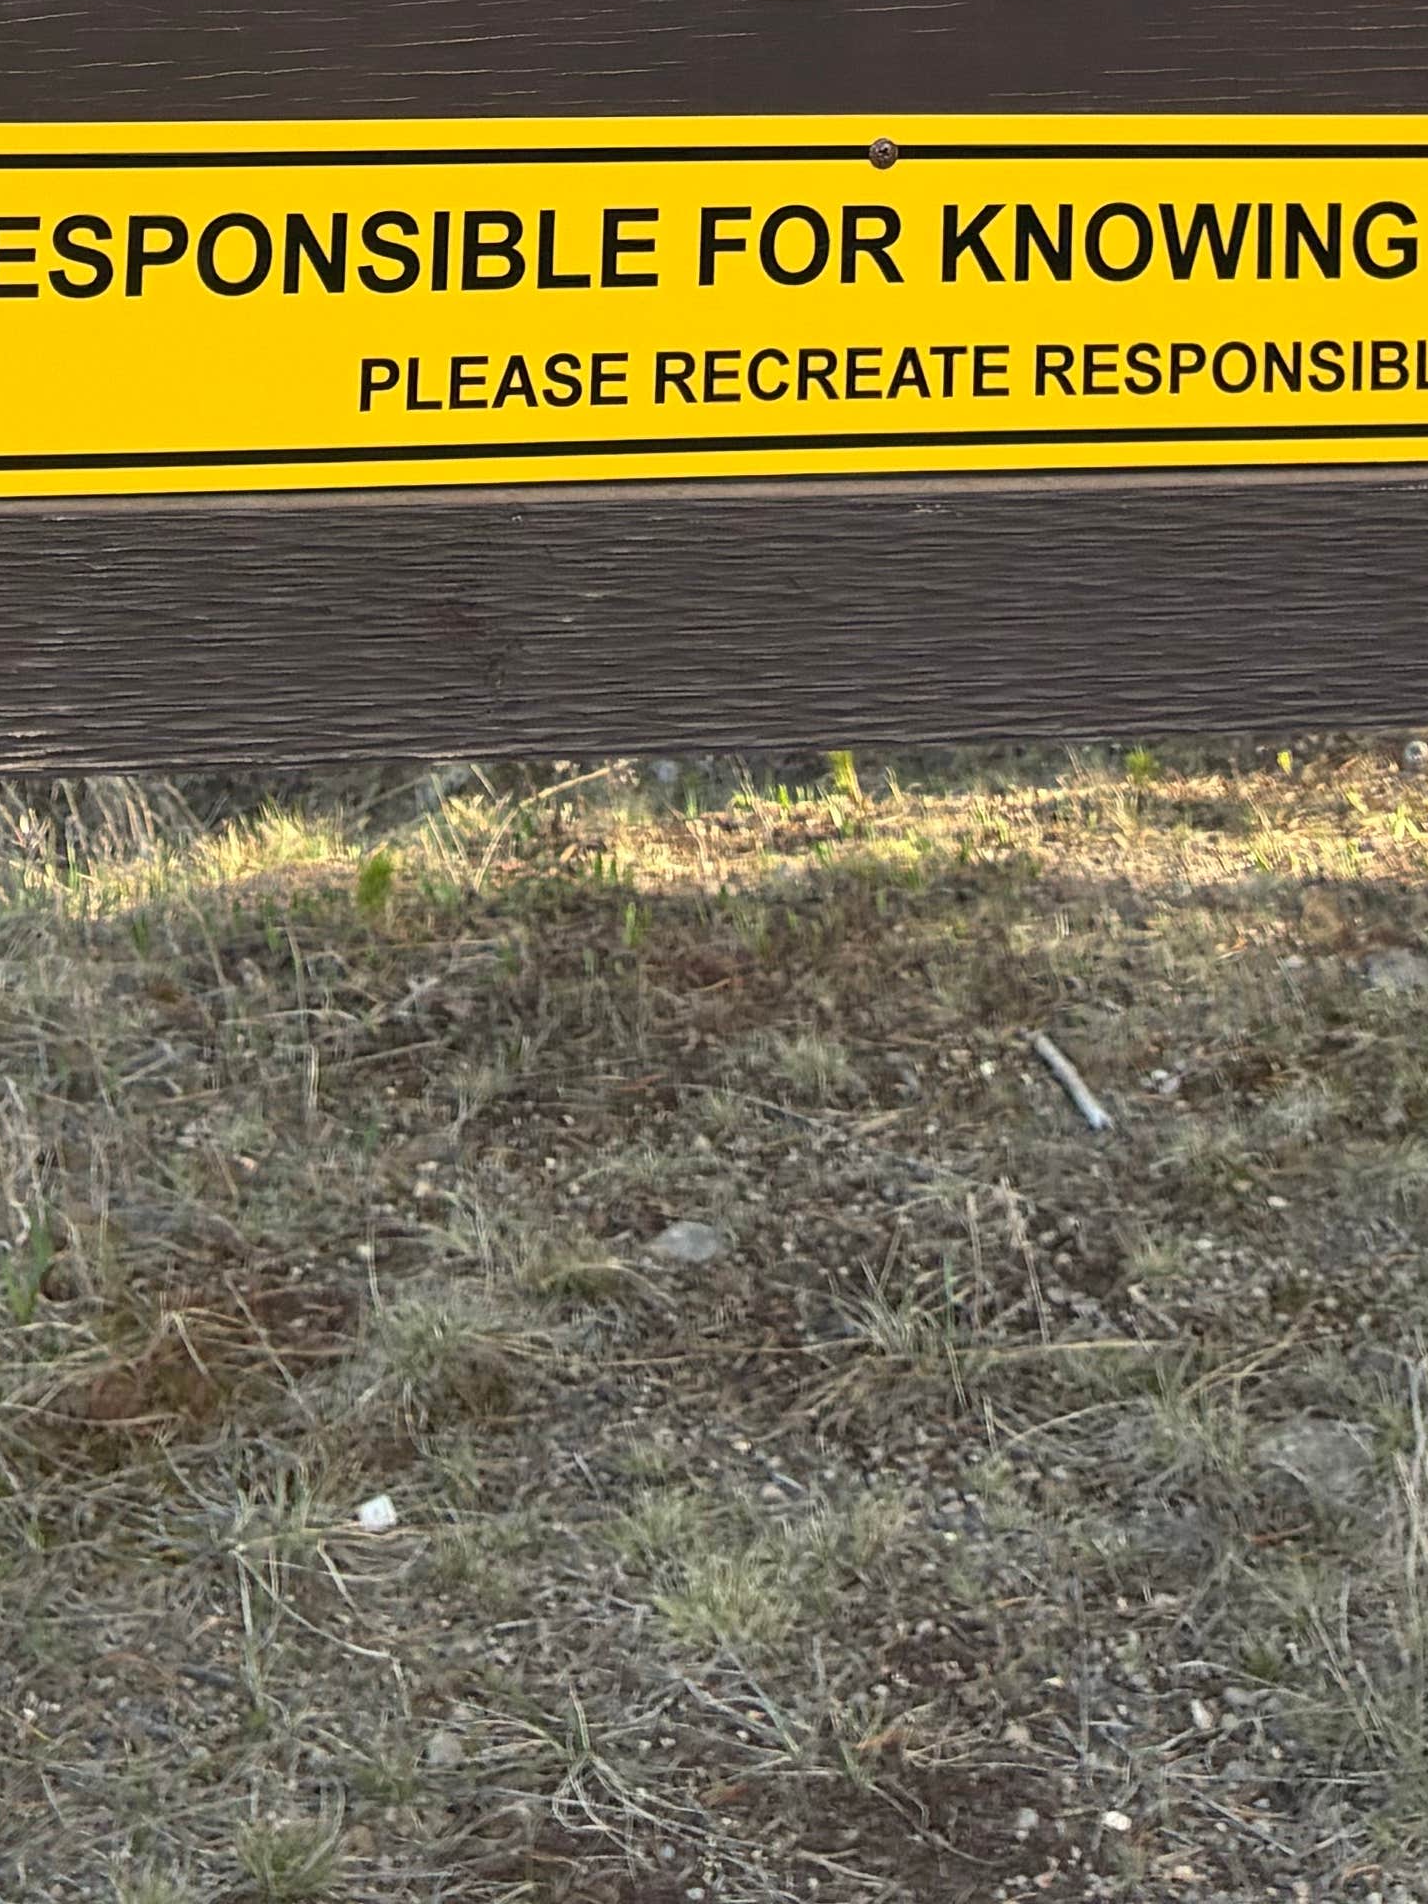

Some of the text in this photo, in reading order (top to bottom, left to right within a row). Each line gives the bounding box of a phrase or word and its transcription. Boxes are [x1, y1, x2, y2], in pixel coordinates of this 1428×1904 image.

[699, 204, 904, 286] FOR
[942, 201, 1417, 282] KNOWING
[360, 352, 628, 412] PLEASE
[655, 345, 1009, 404] RECREATE
